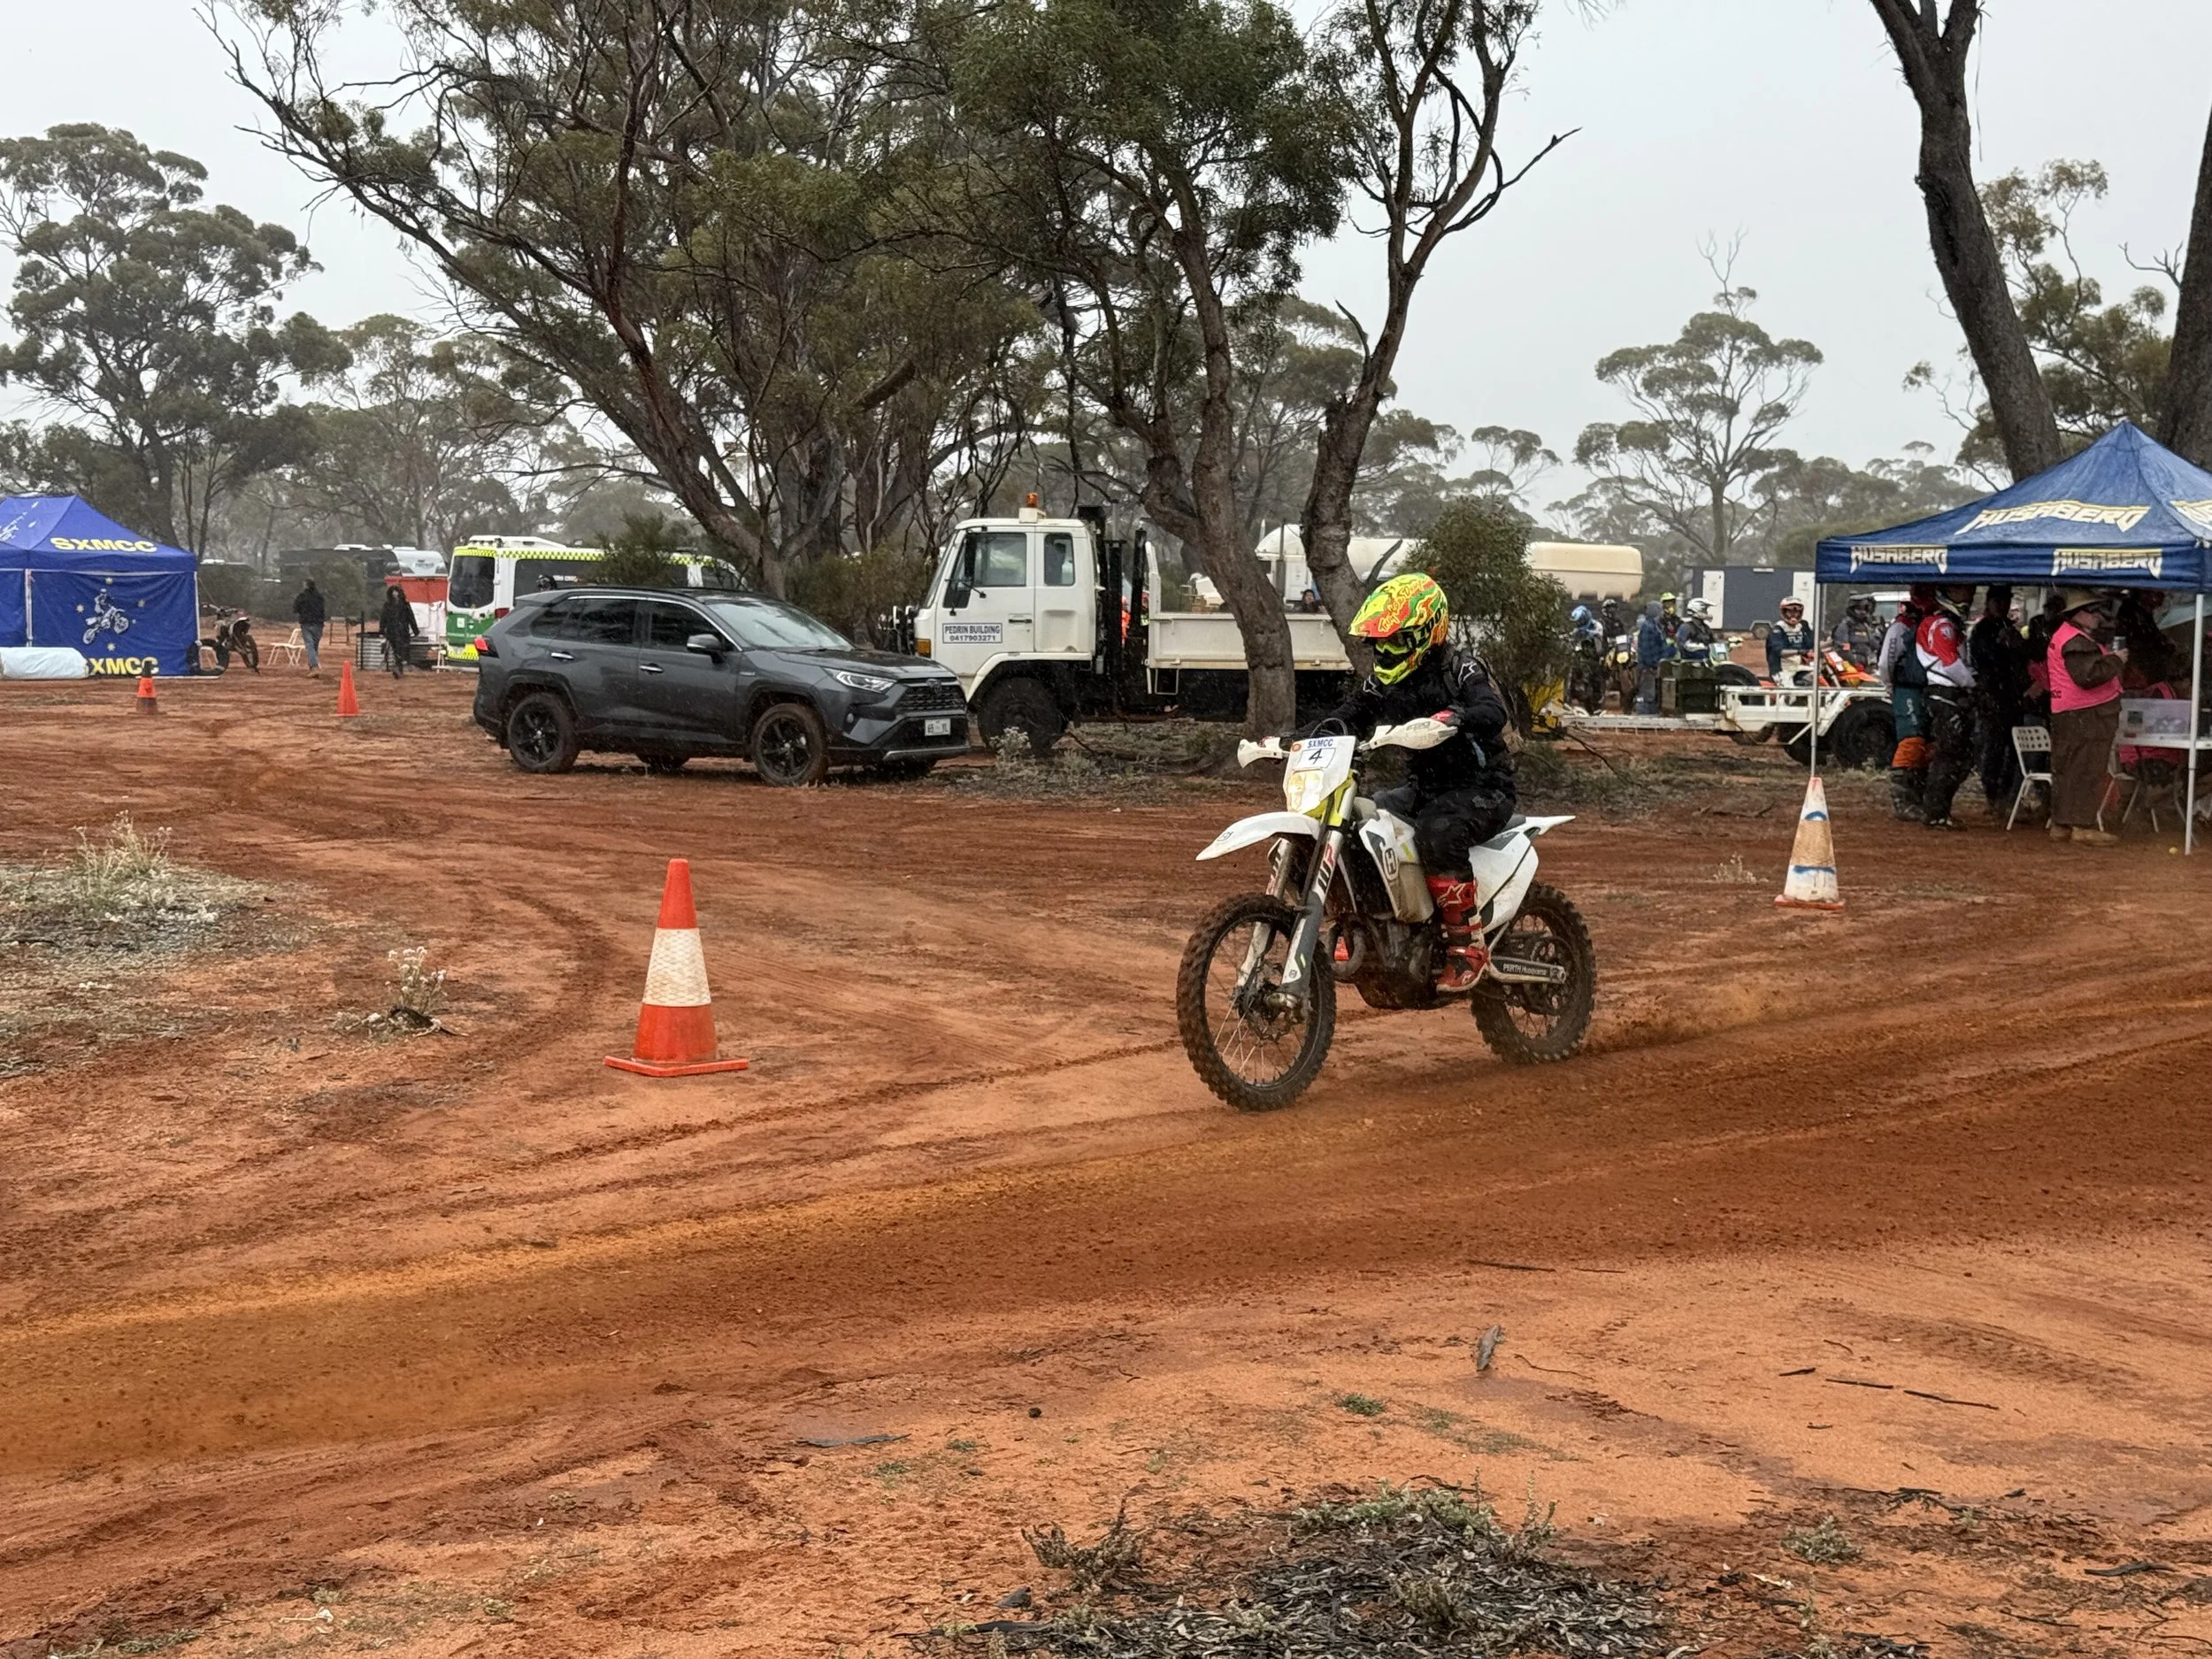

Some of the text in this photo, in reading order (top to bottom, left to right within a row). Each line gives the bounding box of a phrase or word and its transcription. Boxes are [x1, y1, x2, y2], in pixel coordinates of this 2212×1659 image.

[1954, 500, 2151, 536] HUSABERG
[50, 537, 157, 552] SXMCC
[1850, 544, 1947, 574] HUSABERG
[2051, 549, 2162, 578] HUSABERG
[88, 657, 159, 675] XMCC
[1308, 739, 1333, 749] SXMCC
[1309, 749, 1323, 764] 4
